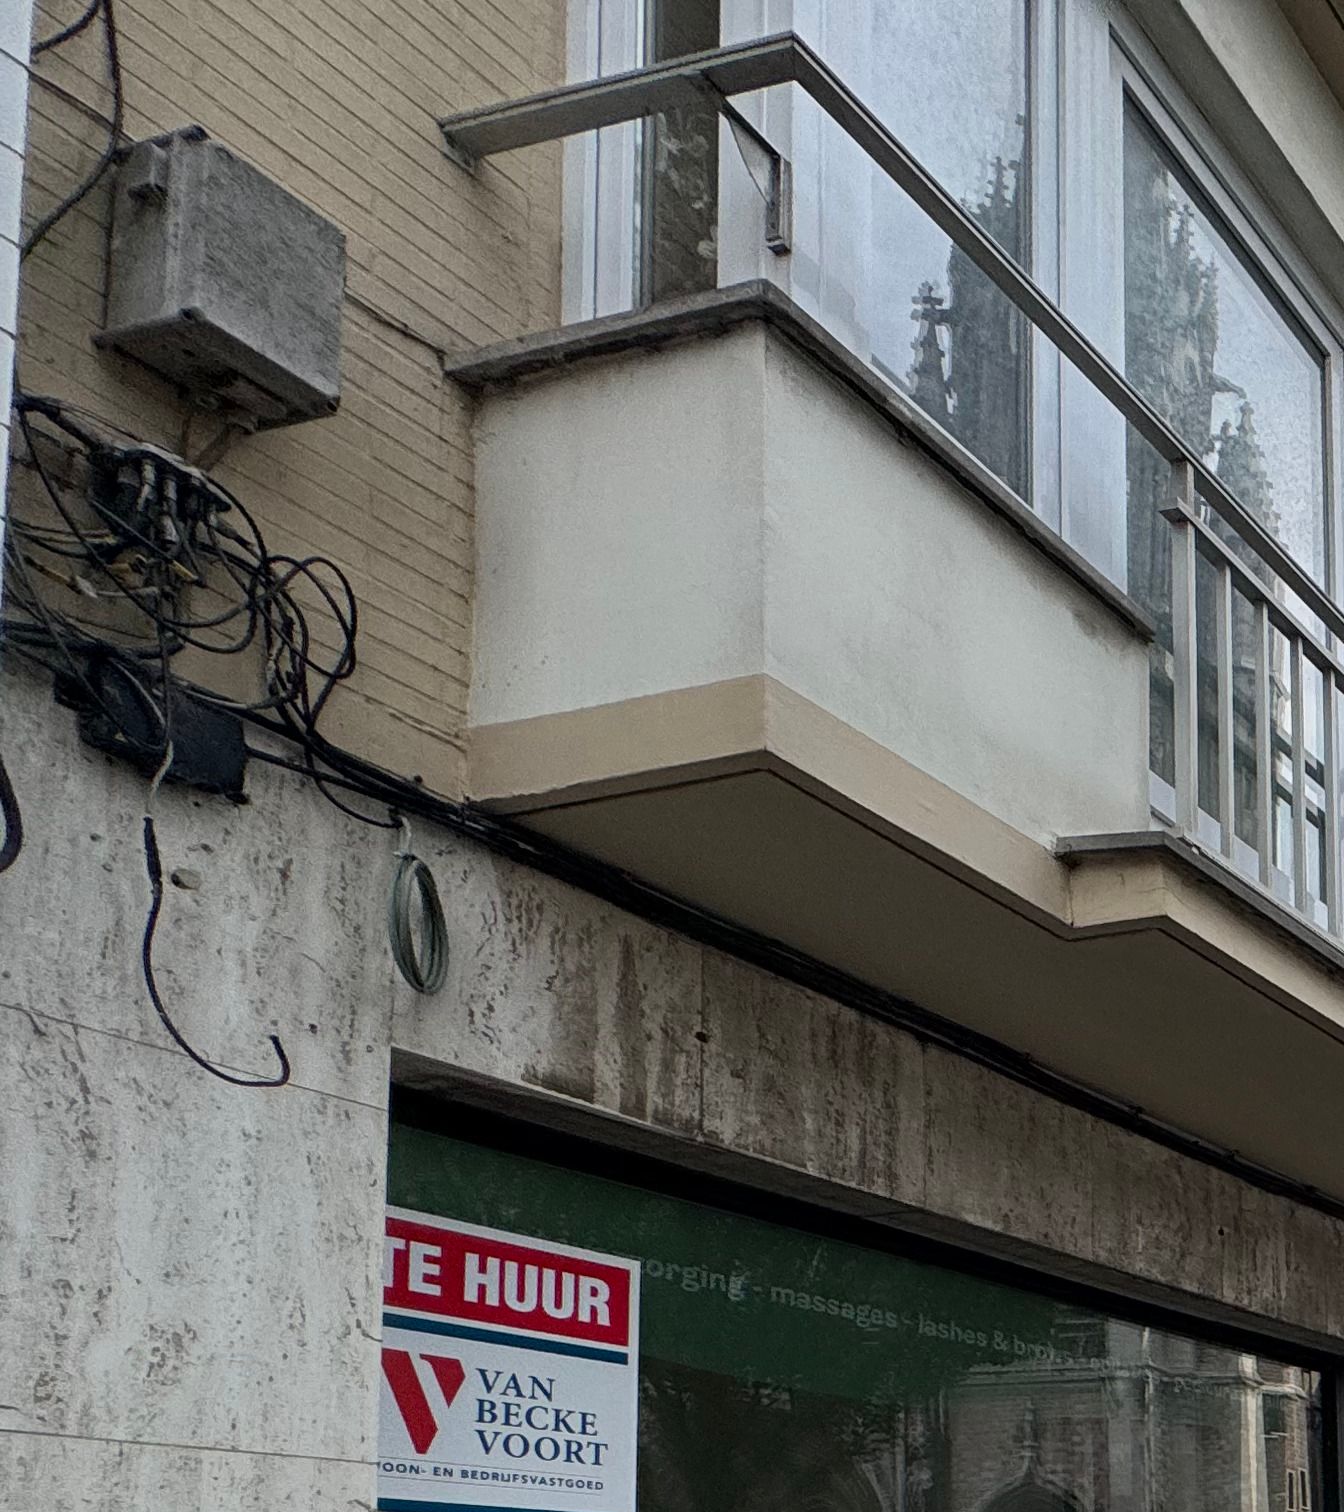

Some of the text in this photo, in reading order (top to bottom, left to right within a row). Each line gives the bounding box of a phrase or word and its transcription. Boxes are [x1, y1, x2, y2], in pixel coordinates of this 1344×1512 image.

[383, 1235, 611, 1327] TE HUUR
[770, 1285, 898, 1328] massages
[917, 1312, 987, 1348] lashes
[475, 1367, 556, 1402] VAN
[474, 1398, 598, 1436] BECKE
[473, 1429, 609, 1466] VOORT
[377, 1461, 604, 1491] OON- EN BEDRIJFSVASTGOED
